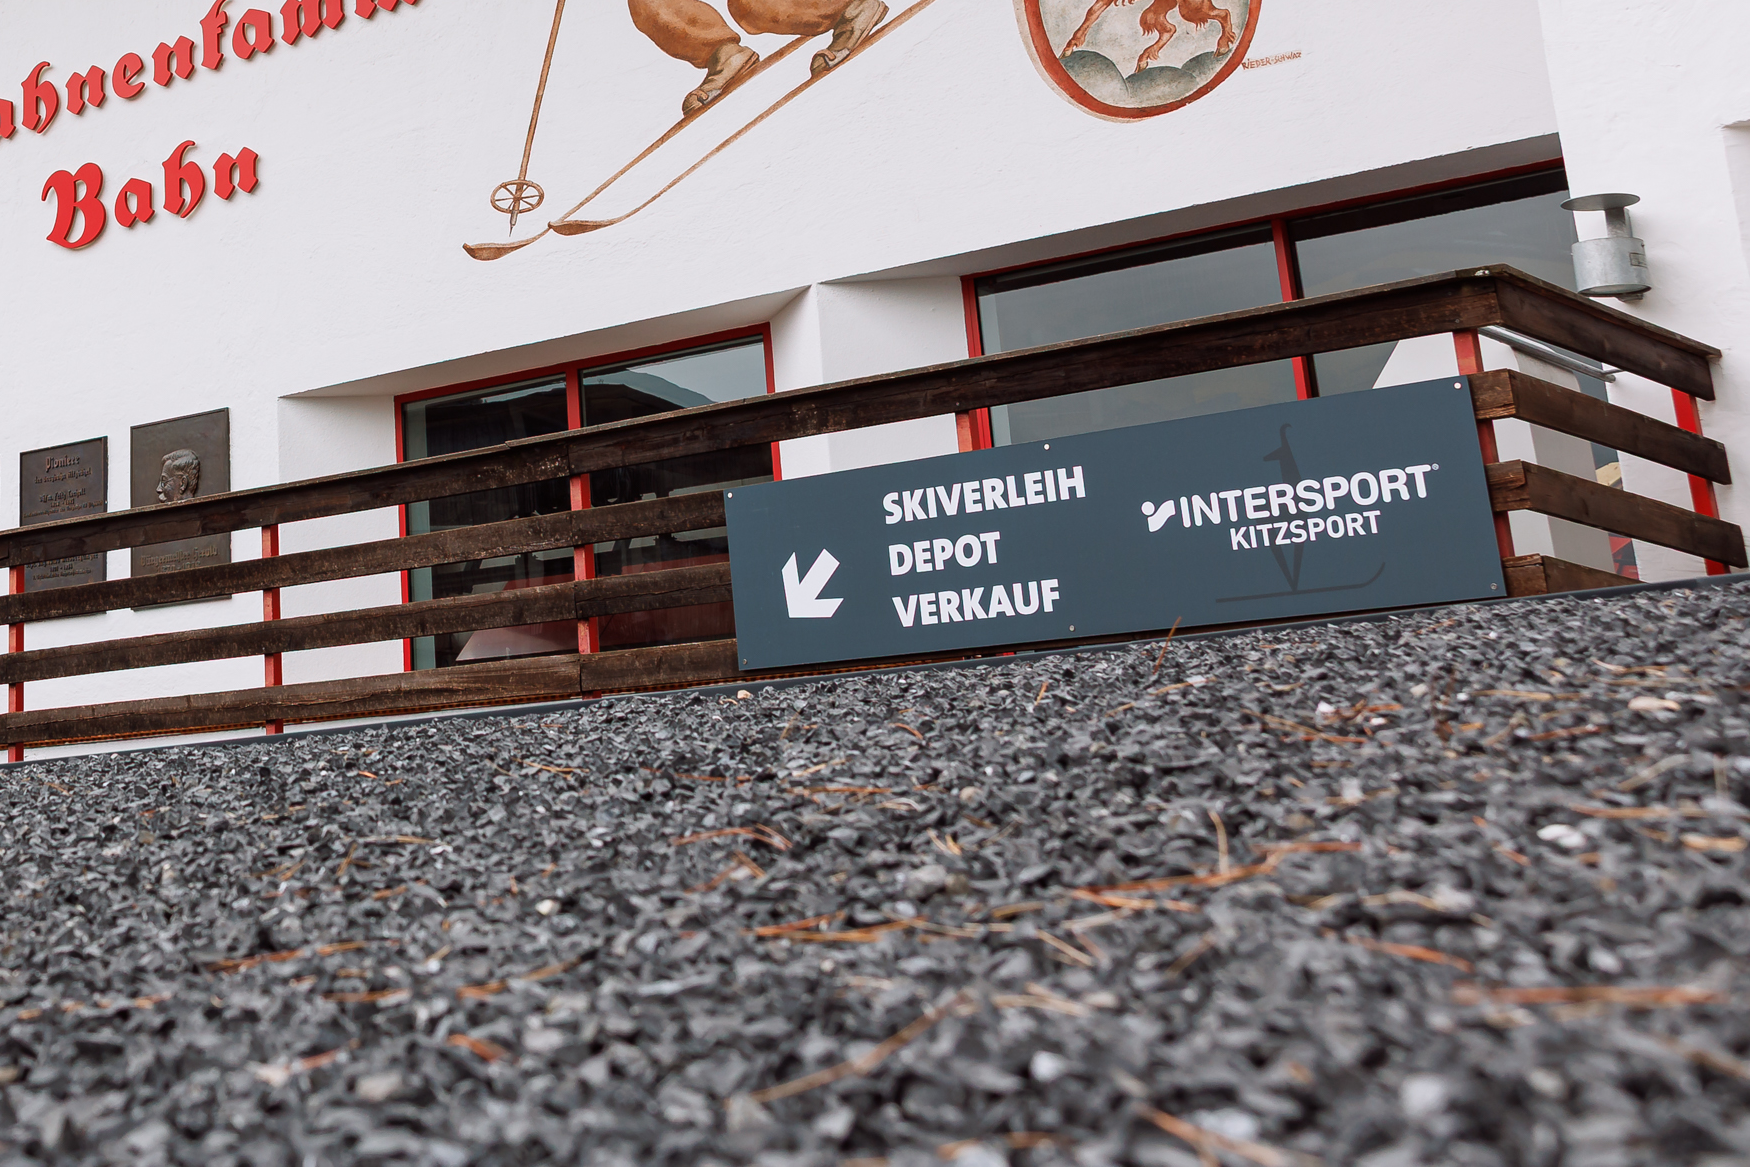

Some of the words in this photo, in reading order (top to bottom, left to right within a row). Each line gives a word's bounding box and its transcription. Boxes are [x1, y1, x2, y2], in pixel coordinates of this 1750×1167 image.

[41, 140, 259, 249] Bahn
[882, 465, 1086, 524] SKIVERLEIH
[888, 531, 1000, 576] DEPOT
[1229, 510, 1381, 551] KITZSPORT
[891, 578, 1060, 627] VERKAUF
